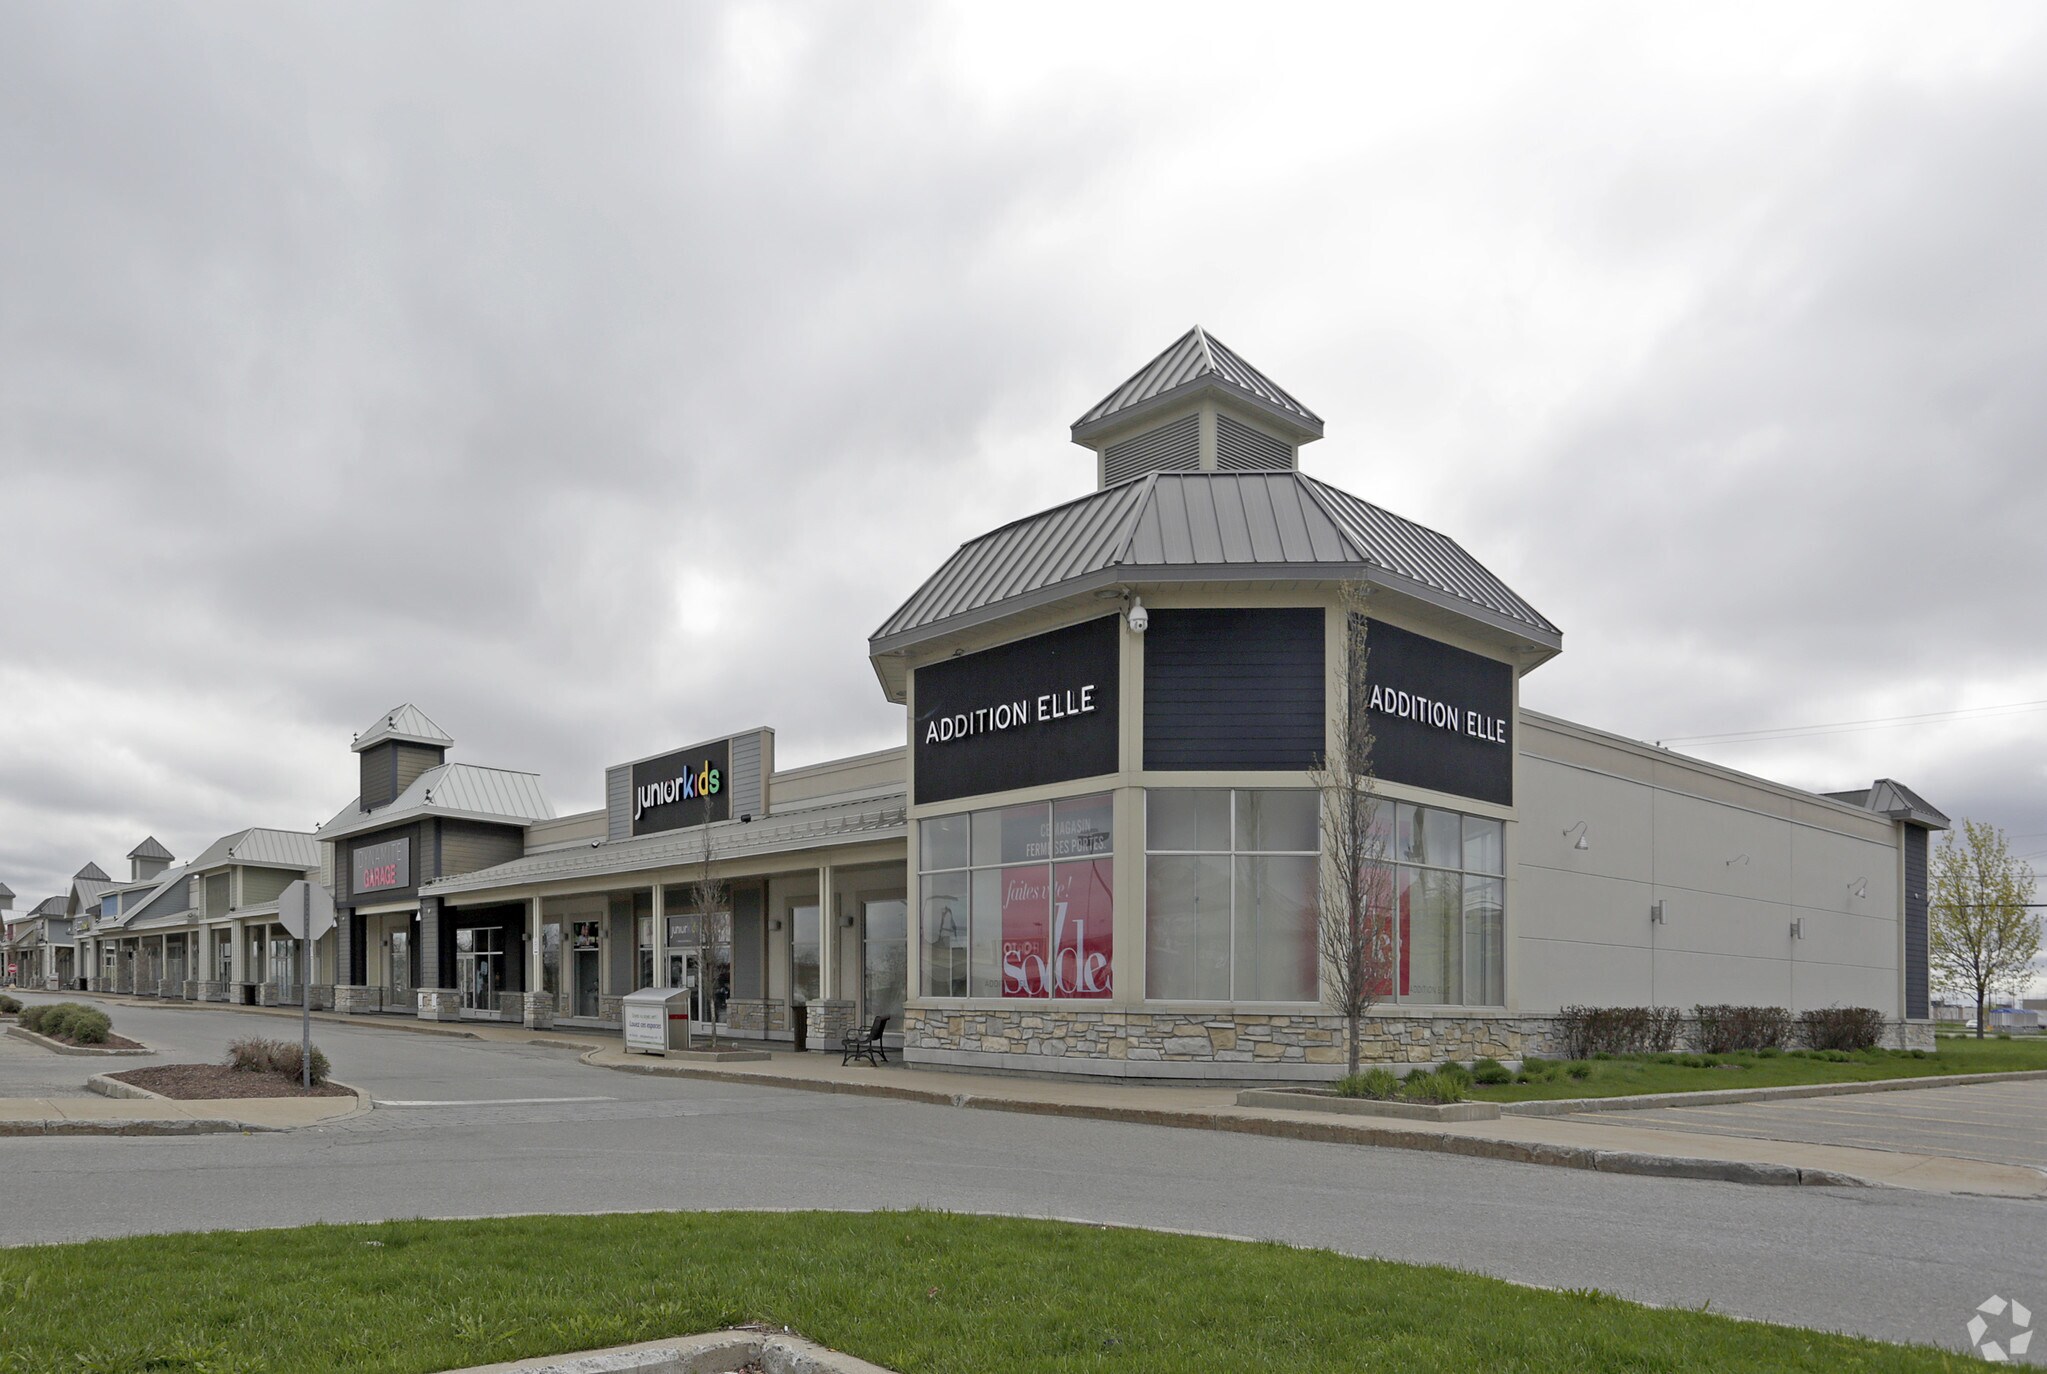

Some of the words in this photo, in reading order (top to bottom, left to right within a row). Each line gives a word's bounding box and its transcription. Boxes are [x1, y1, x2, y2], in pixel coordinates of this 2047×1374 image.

[926, 700, 1028, 744] ADDITION
[1038, 685, 1095, 721] ELLE
[1370, 684, 1458, 731] ADDITION
[1467, 711, 1506, 743] ELLE
[1054, 818, 1091, 836] MAGASIN
[363, 864, 397, 889] GARAGE
[1003, 880, 1039, 910] faites
[1041, 876, 1073, 899] vte!
[1003, 902, 1113, 996] solde
